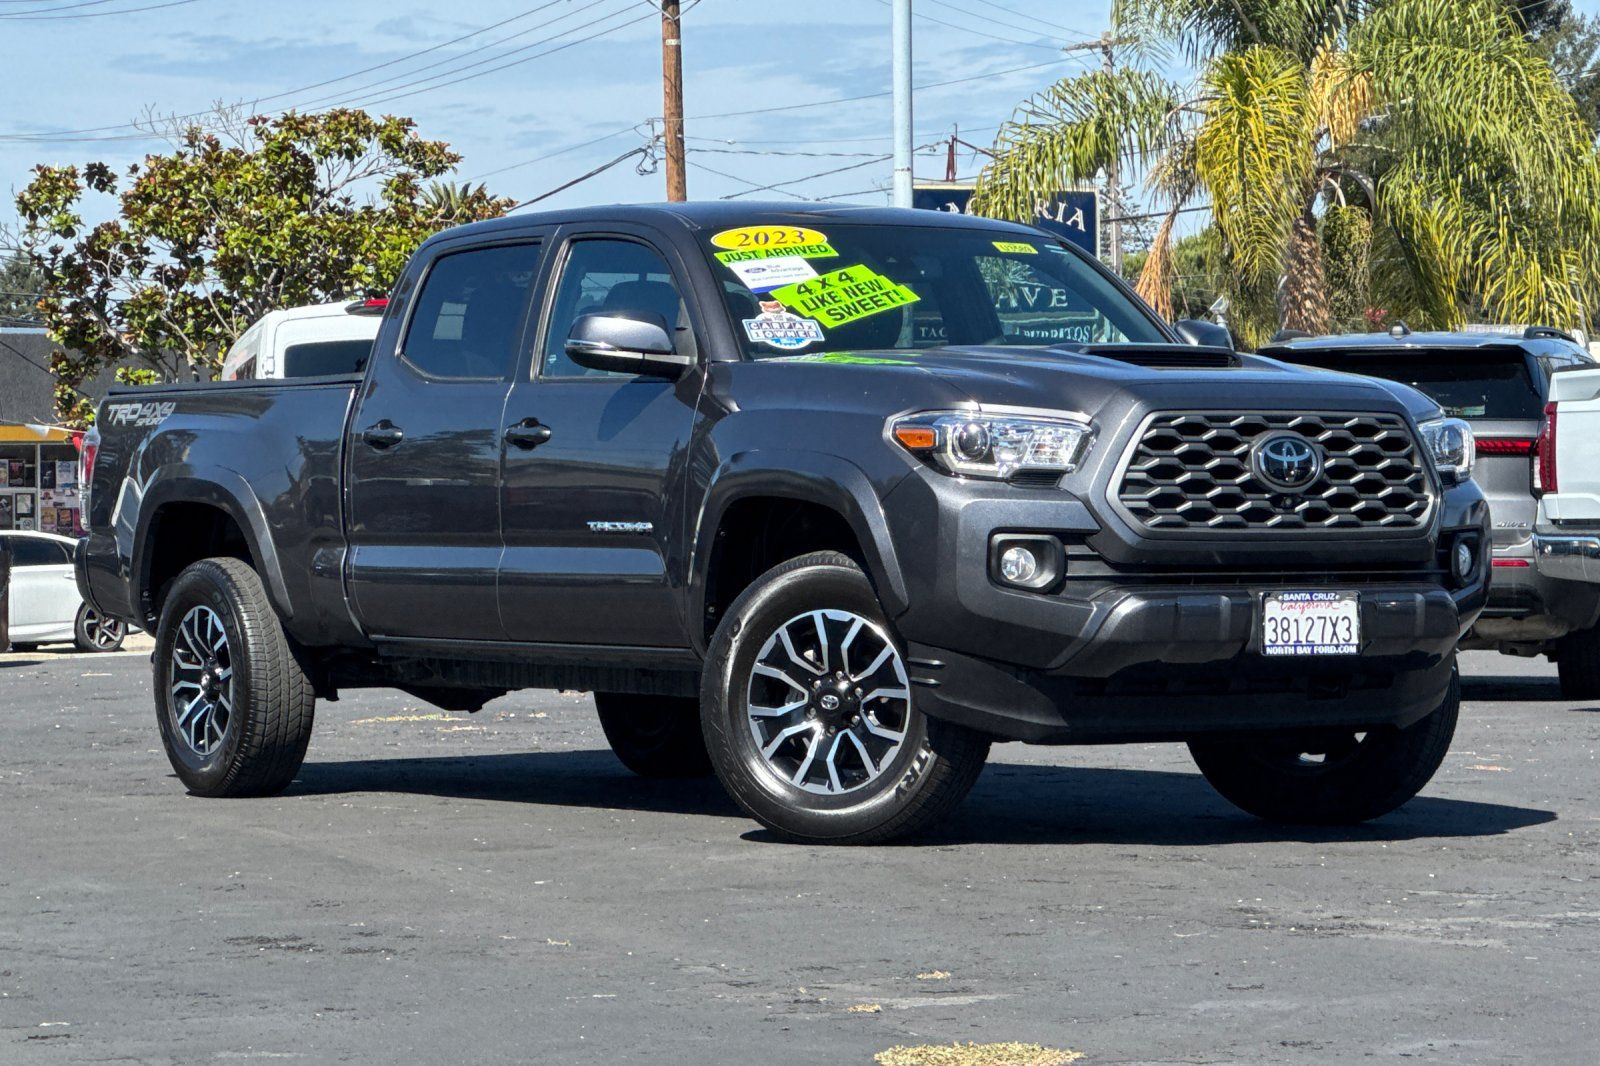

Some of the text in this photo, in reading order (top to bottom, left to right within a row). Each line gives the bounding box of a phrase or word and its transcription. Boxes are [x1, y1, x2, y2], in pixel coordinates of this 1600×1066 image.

[736, 230, 806, 247] 2023
[723, 244, 830, 263] JUST ARRIVED
[796, 283, 815, 296] 4
[837, 271, 855, 284] 4
[800, 279, 883, 312] LIKE NEW
[826, 290, 906, 322] SWEET!
[750, 322, 817, 331] CARFAX
[108, 403, 143, 426] TRD
[1283, 592, 1336, 601] SANTA CRUZ
[1281, 601, 1339, 614] California
[1267, 616, 1353, 644] 38127X3
[1266, 645, 1357, 655] NORTH BAY FORD.COM
